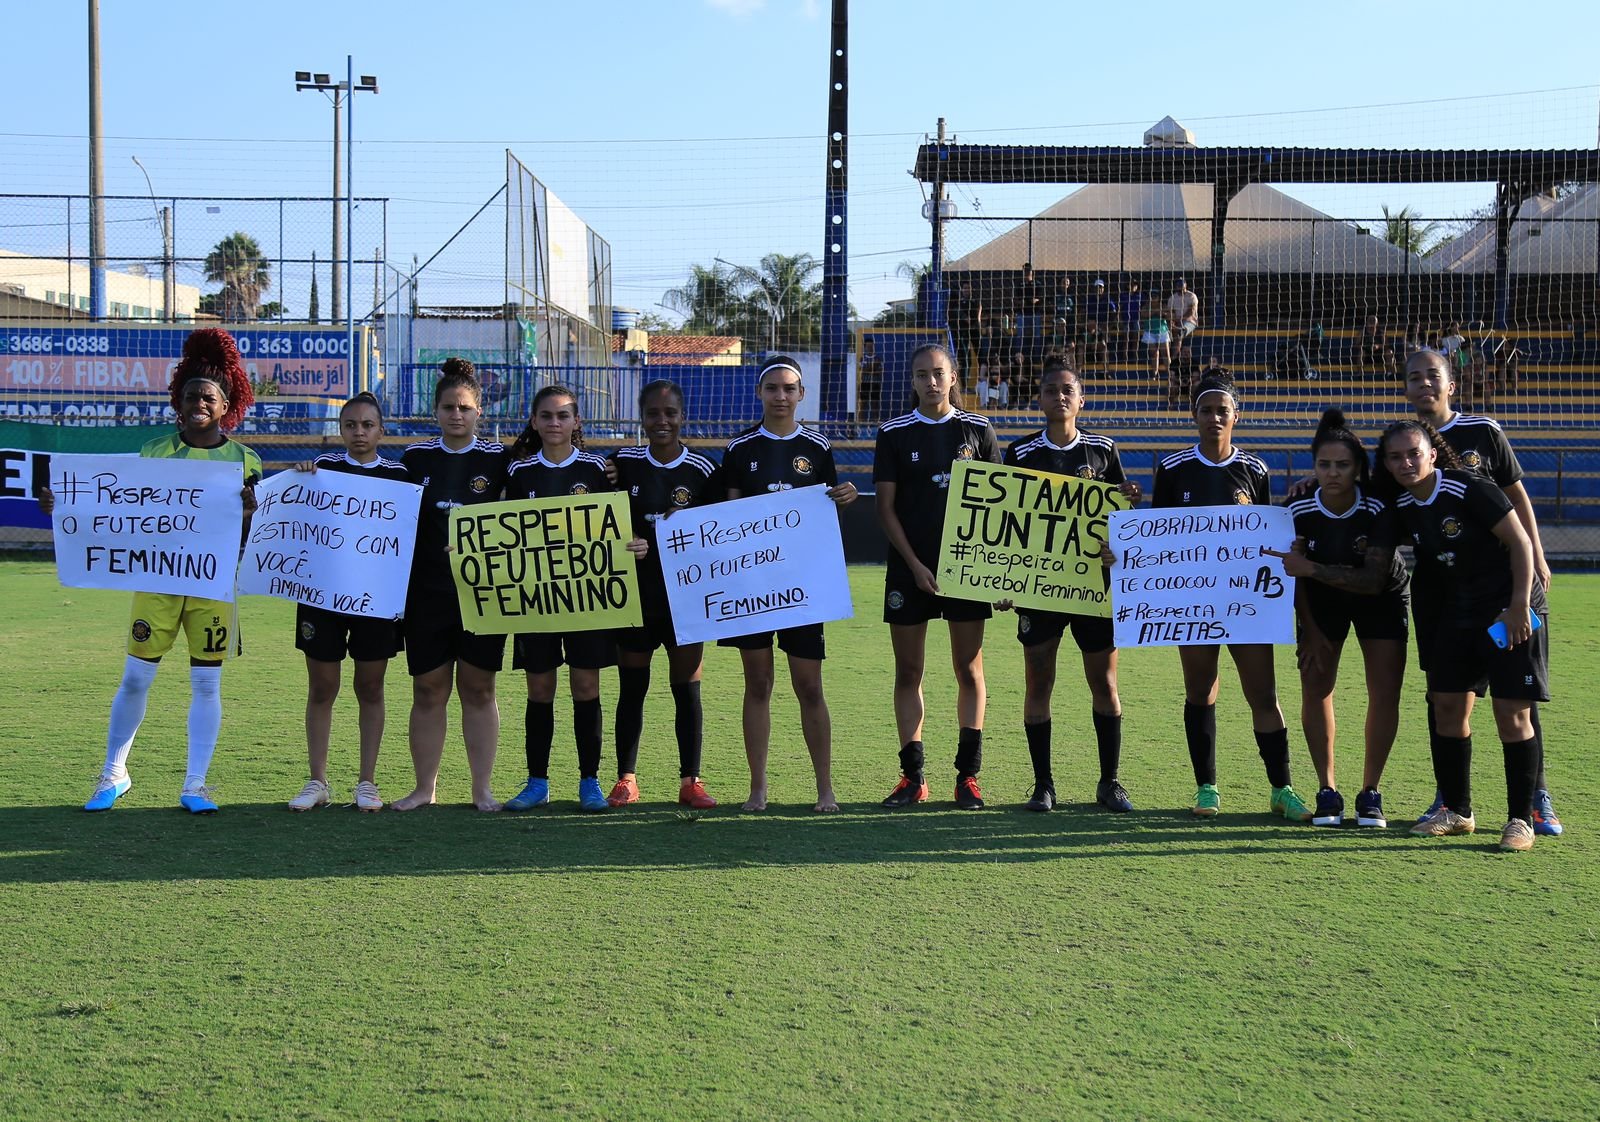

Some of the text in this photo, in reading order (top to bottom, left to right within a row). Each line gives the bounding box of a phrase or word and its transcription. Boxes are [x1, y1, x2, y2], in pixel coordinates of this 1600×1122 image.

[10, 335, 109, 352] 3686-0338
[259, 338, 292, 354] 363
[75, 361, 149, 387] FIBRA
[272, 363, 323, 385] Assine
[324, 364, 344, 391] já!
[64, 404, 116, 427] COM
[961, 468, 1120, 521] ESTAMOS
[62, 514, 201, 535] O FUTEBOL
[456, 504, 621, 554] RESPEITA
[957, 502, 1108, 559] JUNTAS
[251, 521, 400, 557] ESTAMOS COM
[677, 546, 786, 587] AO FUTEBOL
[950, 541, 1065, 573] #Respeita
[1123, 545, 1207, 570] RESPEITA
[269, 577, 325, 605] AMAMOS
[960, 565, 1029, 594] Futebol
[1116, 565, 1285, 599] TE COLOCOU NA A3
[473, 576, 628, 616] FEMININO
[1227, 602, 1257, 617] AS
[203, 626, 228, 653] 12
[1137, 621, 1230, 644] ATLETAS.
